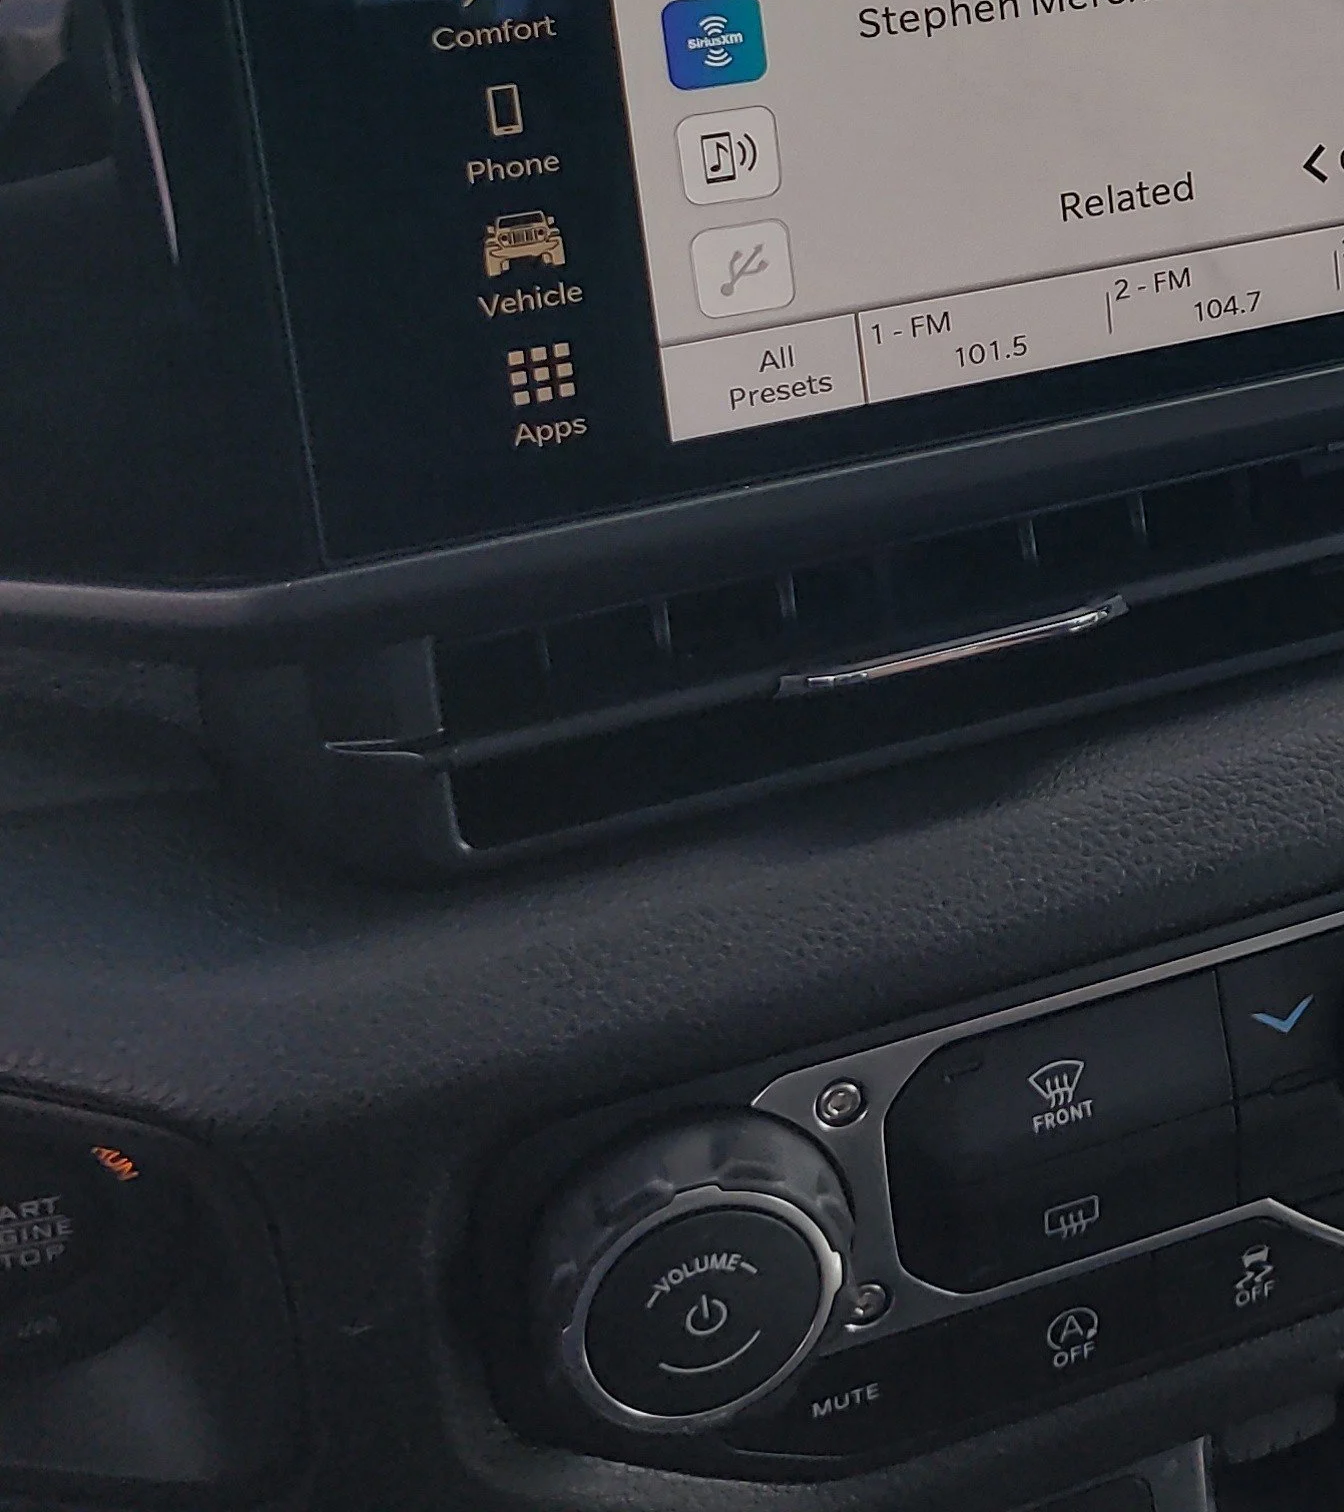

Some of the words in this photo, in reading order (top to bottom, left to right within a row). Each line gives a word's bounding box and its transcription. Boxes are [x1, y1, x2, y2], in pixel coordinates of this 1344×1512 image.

[432, 16, 556, 51] Comfort
[466, 155, 560, 184] Phone
[1060, 173, 1196, 223] Related
[478, 283, 583, 318] Vehicle
[1115, 279, 1129, 301] 2
[1154, 268, 1193, 294] FM
[1194, 291, 1261, 323] 104.7
[871, 324, 882, 346] 1
[910, 311, 951, 338] FM
[759, 346, 794, 372] All
[954, 335, 1029, 369] 101.5
[729, 373, 834, 411] Presets
[515, 416, 587, 447] Apps
[1032, 1099, 1093, 1134] FRONT
[658, 1253, 741, 1294] VOLUME
[1235, 1280, 1275, 1308] OFF
[1053, 1341, 1096, 1368] OFF
[811, 1383, 880, 1418] MUTE
